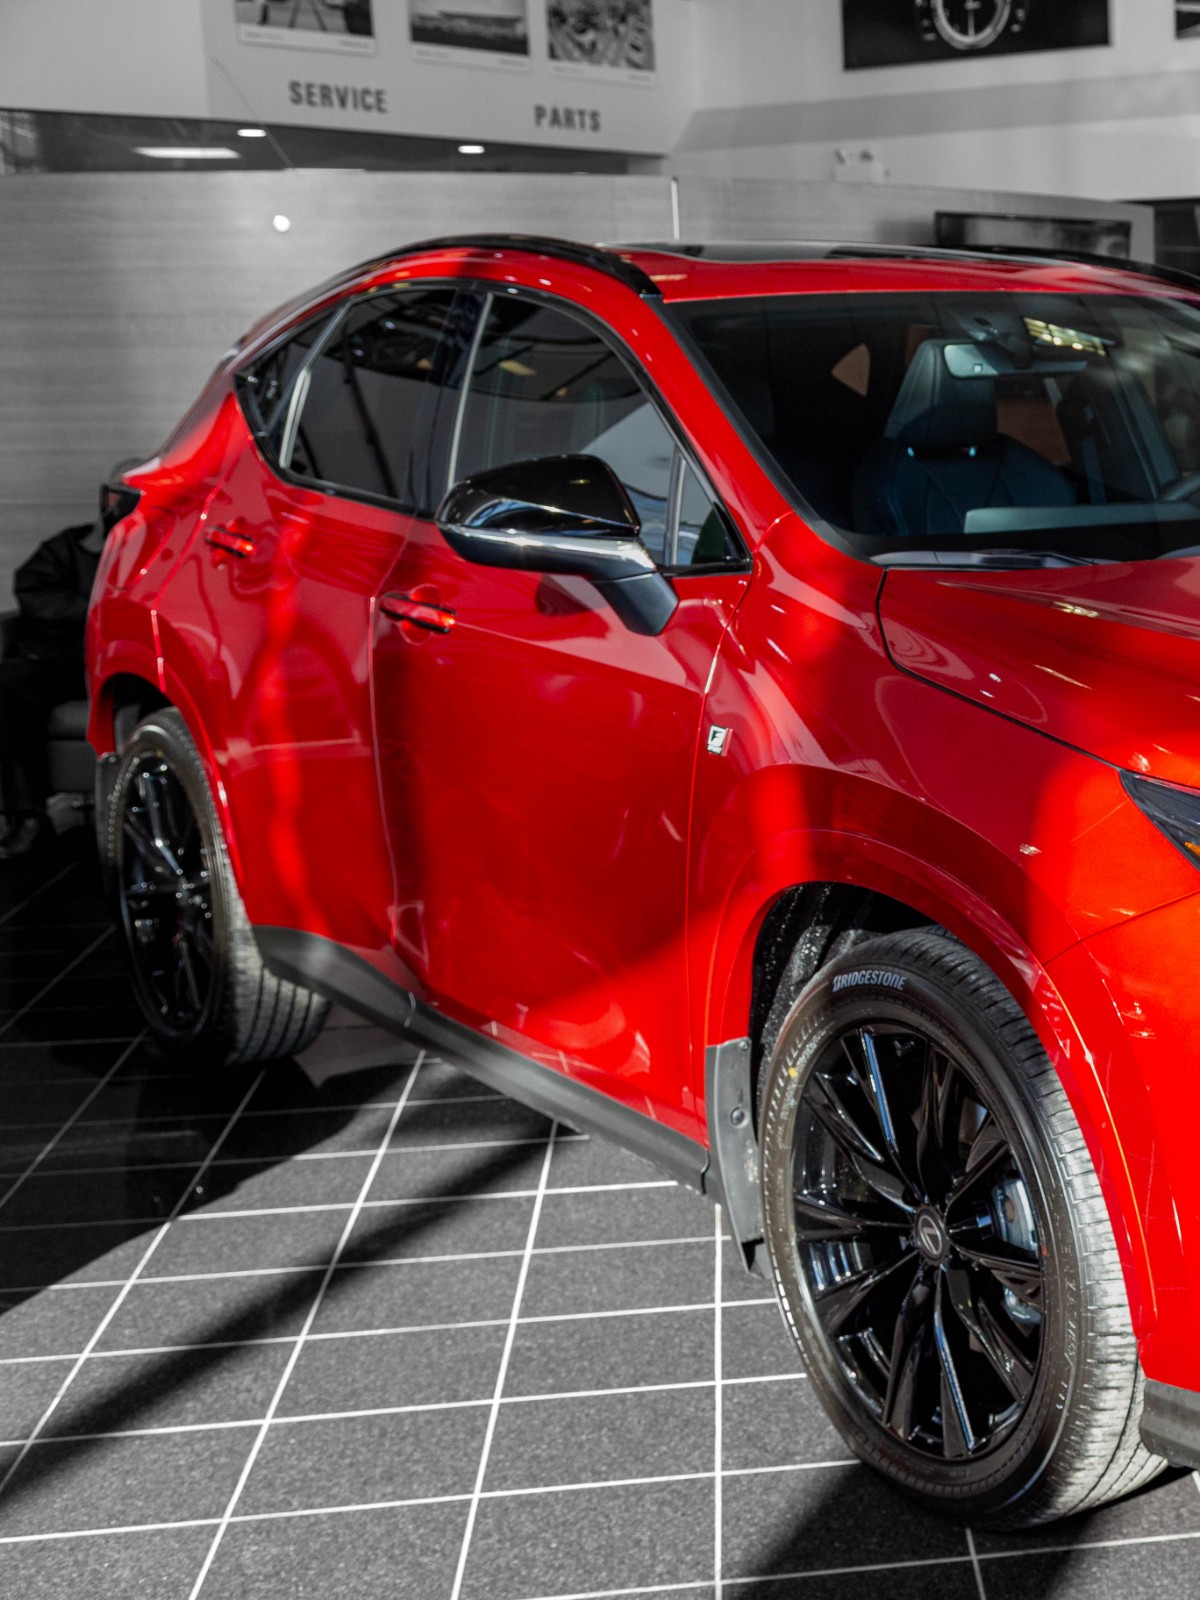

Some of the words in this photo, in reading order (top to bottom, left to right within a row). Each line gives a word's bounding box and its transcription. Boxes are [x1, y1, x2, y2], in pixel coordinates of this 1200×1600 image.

[288, 80, 388, 114] SERVICE
[534, 105, 601, 132] PARTS
[833, 970, 906, 991] BRIDGESTONE
